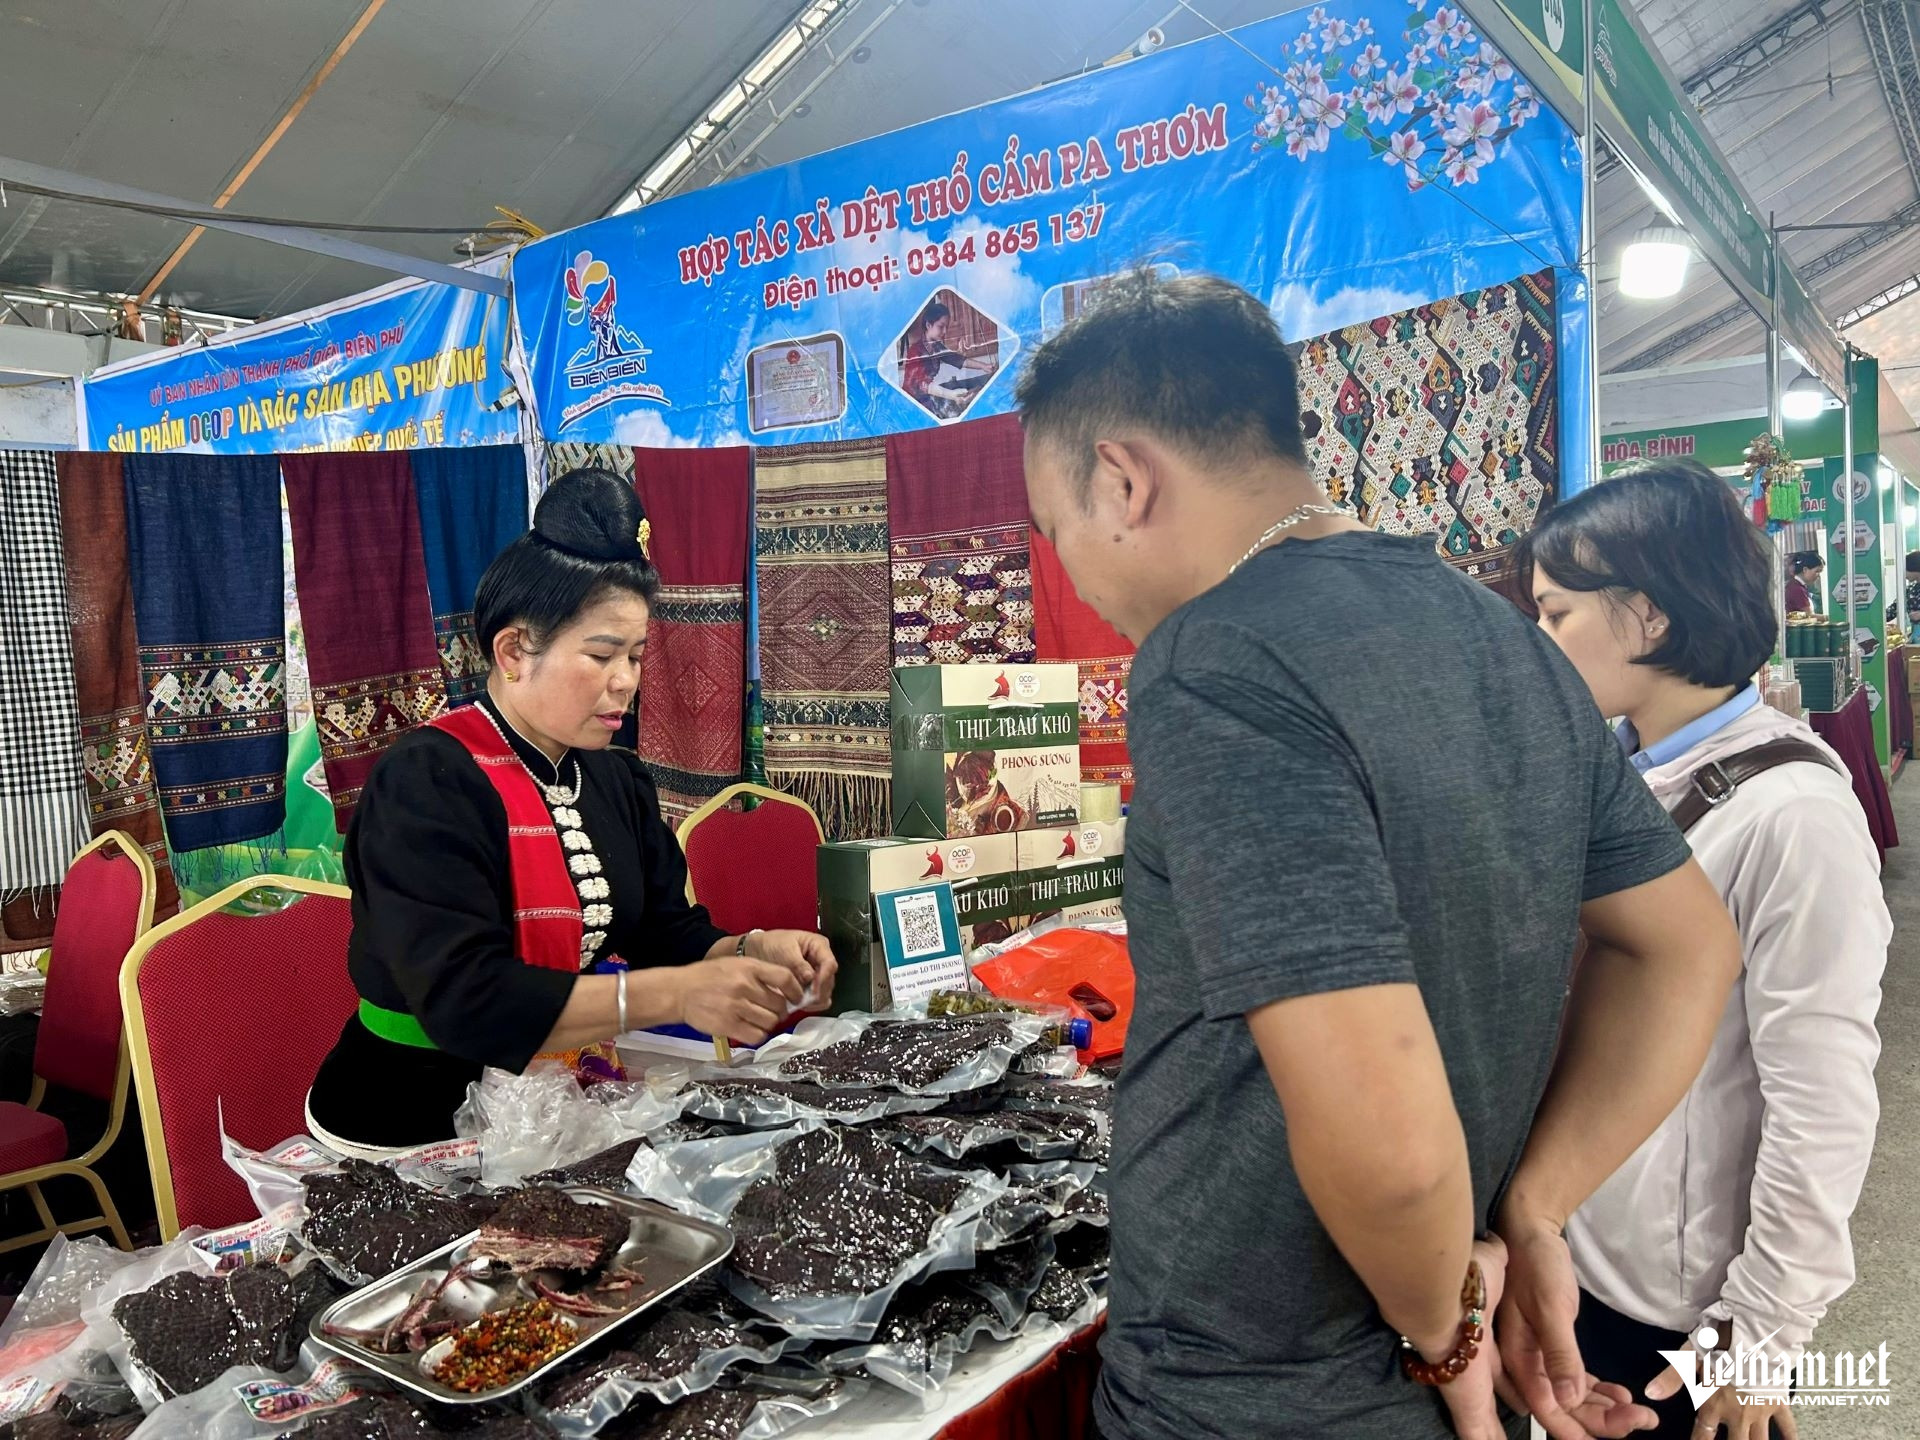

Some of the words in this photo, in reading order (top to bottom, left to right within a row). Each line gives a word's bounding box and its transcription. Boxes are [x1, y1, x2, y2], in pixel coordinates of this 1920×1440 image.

[680, 235, 729, 286] HỢP
[736, 217, 788, 265] TÁC
[795, 198, 835, 251] XÃ
[843, 186, 900, 242] DỆT
[907, 151, 971, 224] THỔ
[980, 135, 1051, 204] CẨM
[1058, 138, 1110, 187] PA
[1117, 104, 1227, 171] THƠM
[765, 275, 817, 309] Điện
[826, 255, 898, 291] thoại:
[907, 238, 975, 275] 0384
[986, 221, 1038, 257] 865
[1049, 204, 1104, 244] 137
[165, 384, 187, 404] BAN
[189, 371, 220, 398] NHÂN
[221, 365, 240, 391] DÂN
[284, 344, 314, 375] PHỐ
[345, 330, 377, 359] BIÊN
[380, 317, 405, 351] PHỦ
[108, 423, 137, 452] SẢN
[140, 410, 186, 452] PHẨM
[190, 407, 233, 444] OCOP
[239, 396, 263, 434] VÀ
[261, 388, 299, 433] ĐẶC
[350, 370, 393, 414] ĐỊA
[394, 344, 487, 400] PHƯƠNG
[385, 417, 419, 450] QUỐC
[422, 410, 445, 444] TẾ
[1603, 438, 1640, 462] HÒA
[1646, 434, 1694, 458] BÌNH
[956, 718, 992, 740] THỊT
[996, 714, 1037, 738] TRÂU
[1041, 712, 1070, 735] KHÔ
[1001, 756, 1038, 769] PHONG
[977, 884, 1009, 911] KHÔ
[1029, 876, 1061, 901] THỊT
[1066, 870, 1099, 893] TRÂU
